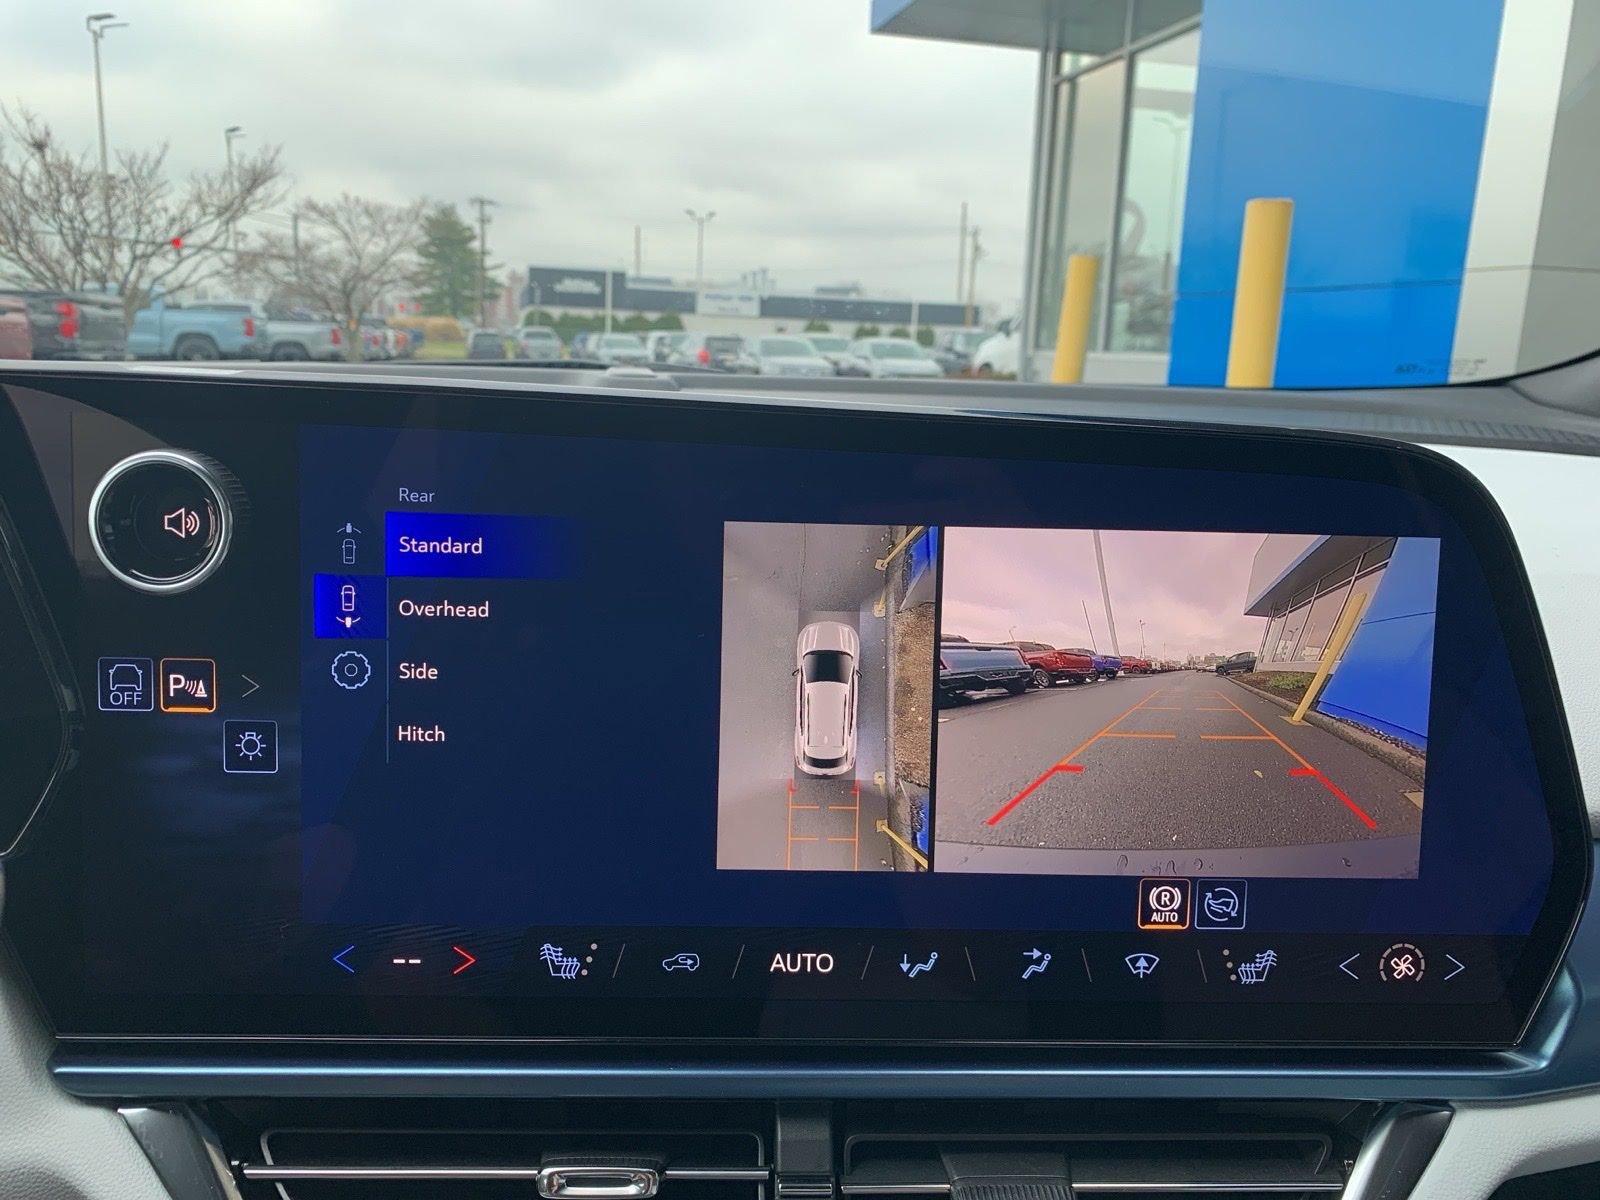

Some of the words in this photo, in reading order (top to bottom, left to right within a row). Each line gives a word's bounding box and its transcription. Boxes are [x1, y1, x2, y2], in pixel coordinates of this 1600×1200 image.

[399, 487, 435, 502] Rear
[399, 536, 483, 554] Standard
[399, 600, 489, 617] Overhead
[399, 662, 438, 679] Side
[169, 674, 184, 697] P
[110, 691, 142, 705] OFF
[398, 725, 446, 742] Hitch
[1161, 891, 1170, 906] R
[1151, 911, 1178, 923] AUTO
[769, 953, 834, 973] AUTO
